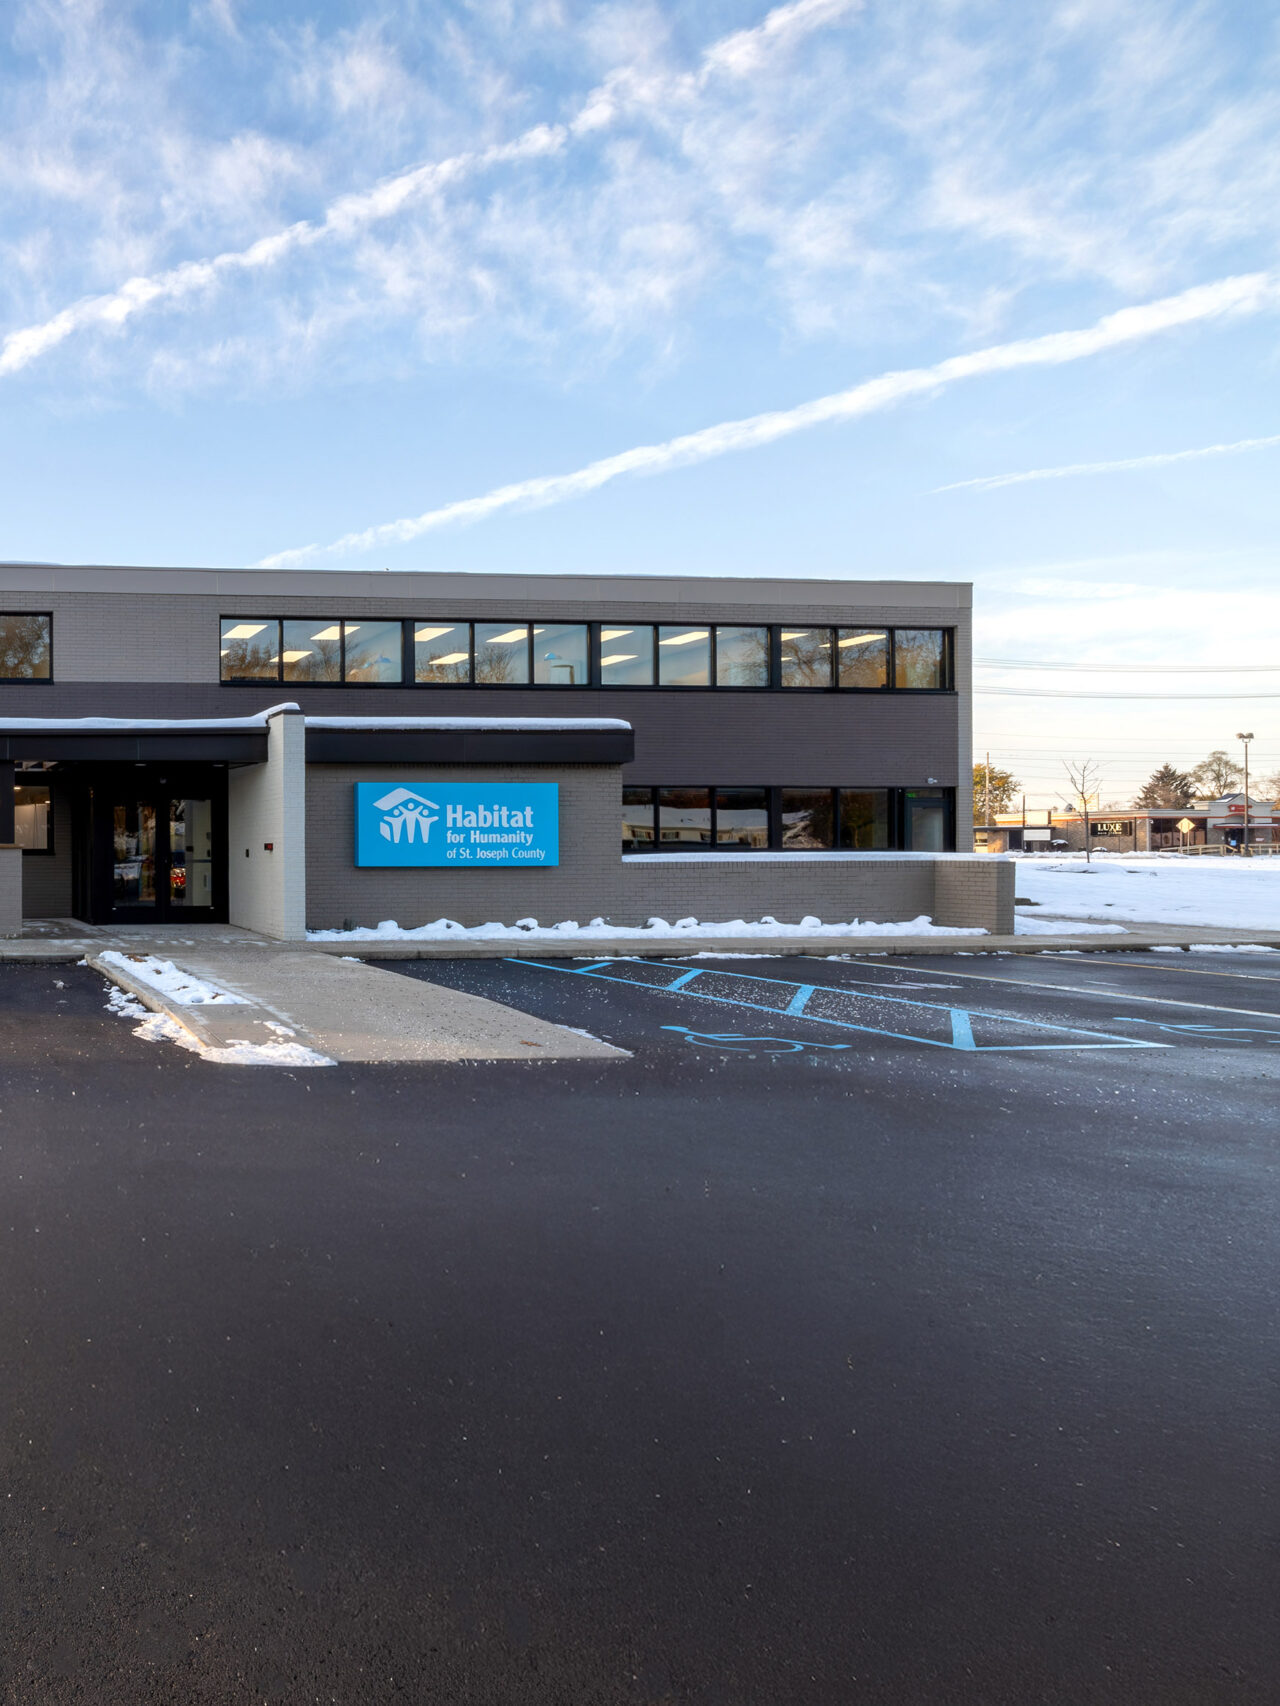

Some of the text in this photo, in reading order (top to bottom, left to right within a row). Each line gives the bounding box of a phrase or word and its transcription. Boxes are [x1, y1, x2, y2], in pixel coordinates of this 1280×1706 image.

[446, 804, 534, 828] Habitat
[1097, 823, 1122, 832] LUXE
[447, 830, 533, 846] for Humanity
[446, 847, 546, 861] of St. Joseph County
